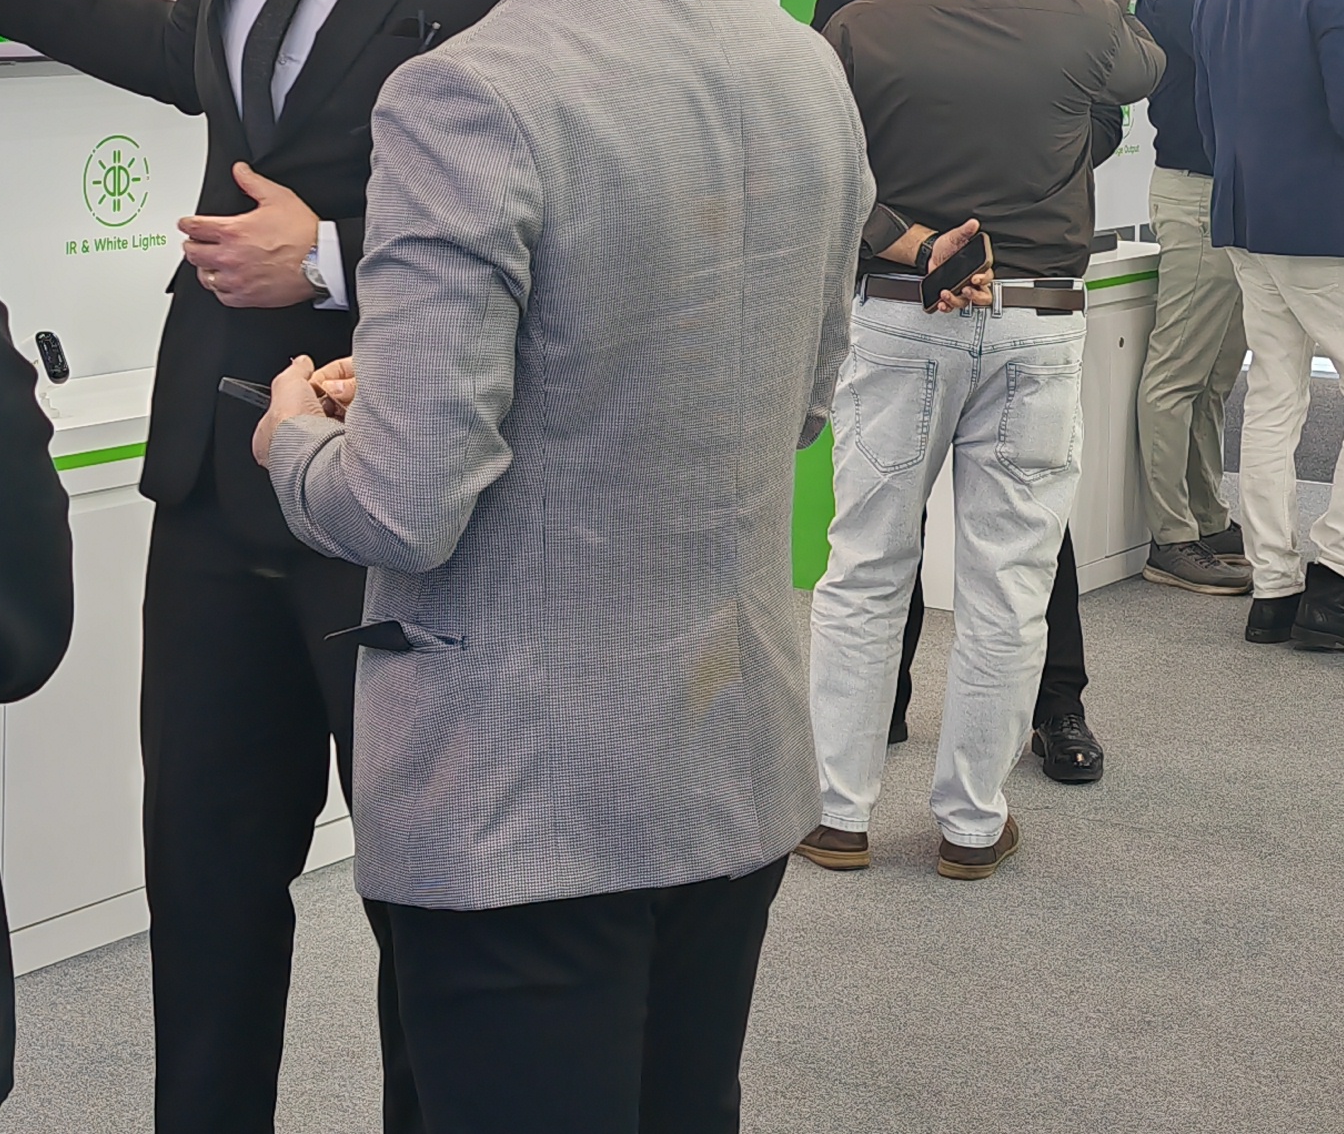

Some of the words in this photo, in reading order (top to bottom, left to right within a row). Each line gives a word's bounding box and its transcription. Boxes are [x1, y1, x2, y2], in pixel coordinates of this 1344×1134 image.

[66, 241, 78, 255] IR
[81, 240, 90, 254] &
[94, 236, 128, 253] White
[131, 233, 167, 251] Lights
